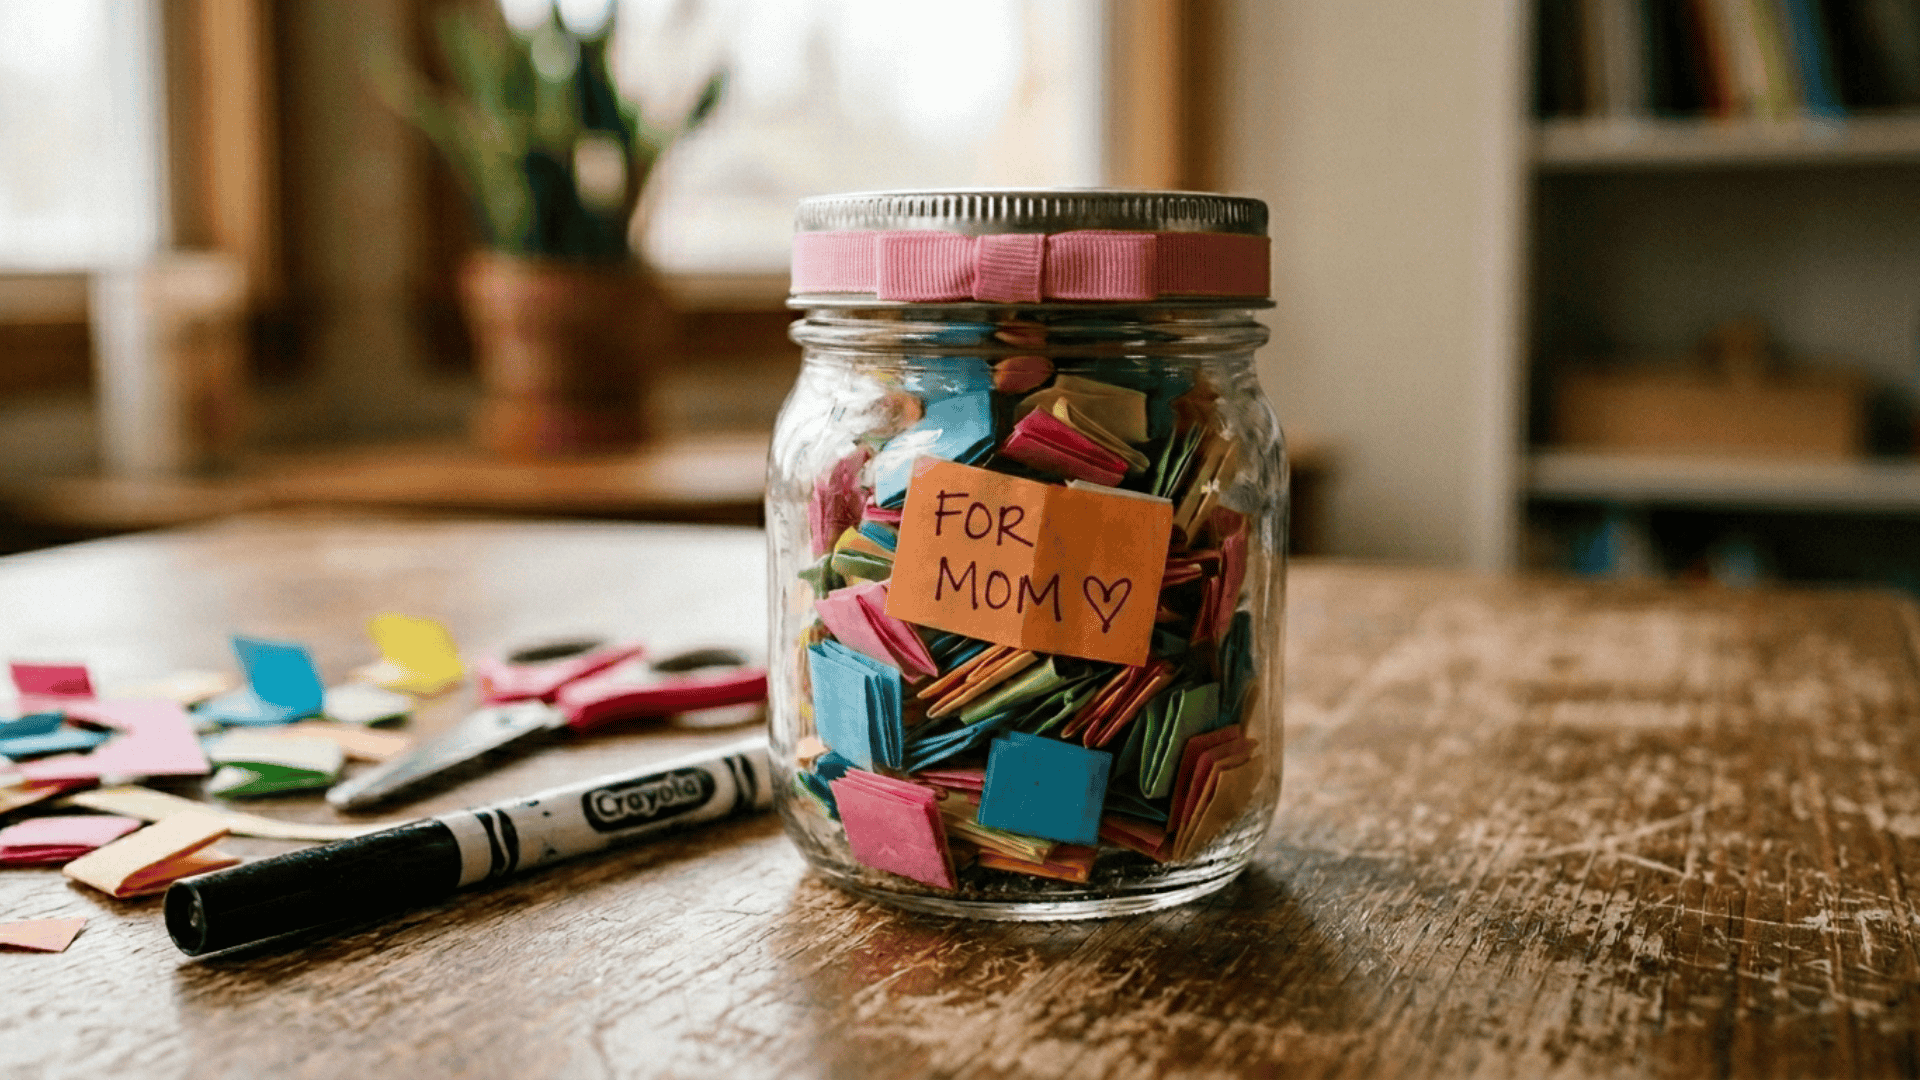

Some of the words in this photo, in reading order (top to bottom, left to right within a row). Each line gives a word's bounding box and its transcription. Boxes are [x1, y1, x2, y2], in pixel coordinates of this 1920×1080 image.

[934, 490, 1034, 547] FOR
[934, 556, 1062, 623] MOM
[592, 772, 702, 821] Crayola
